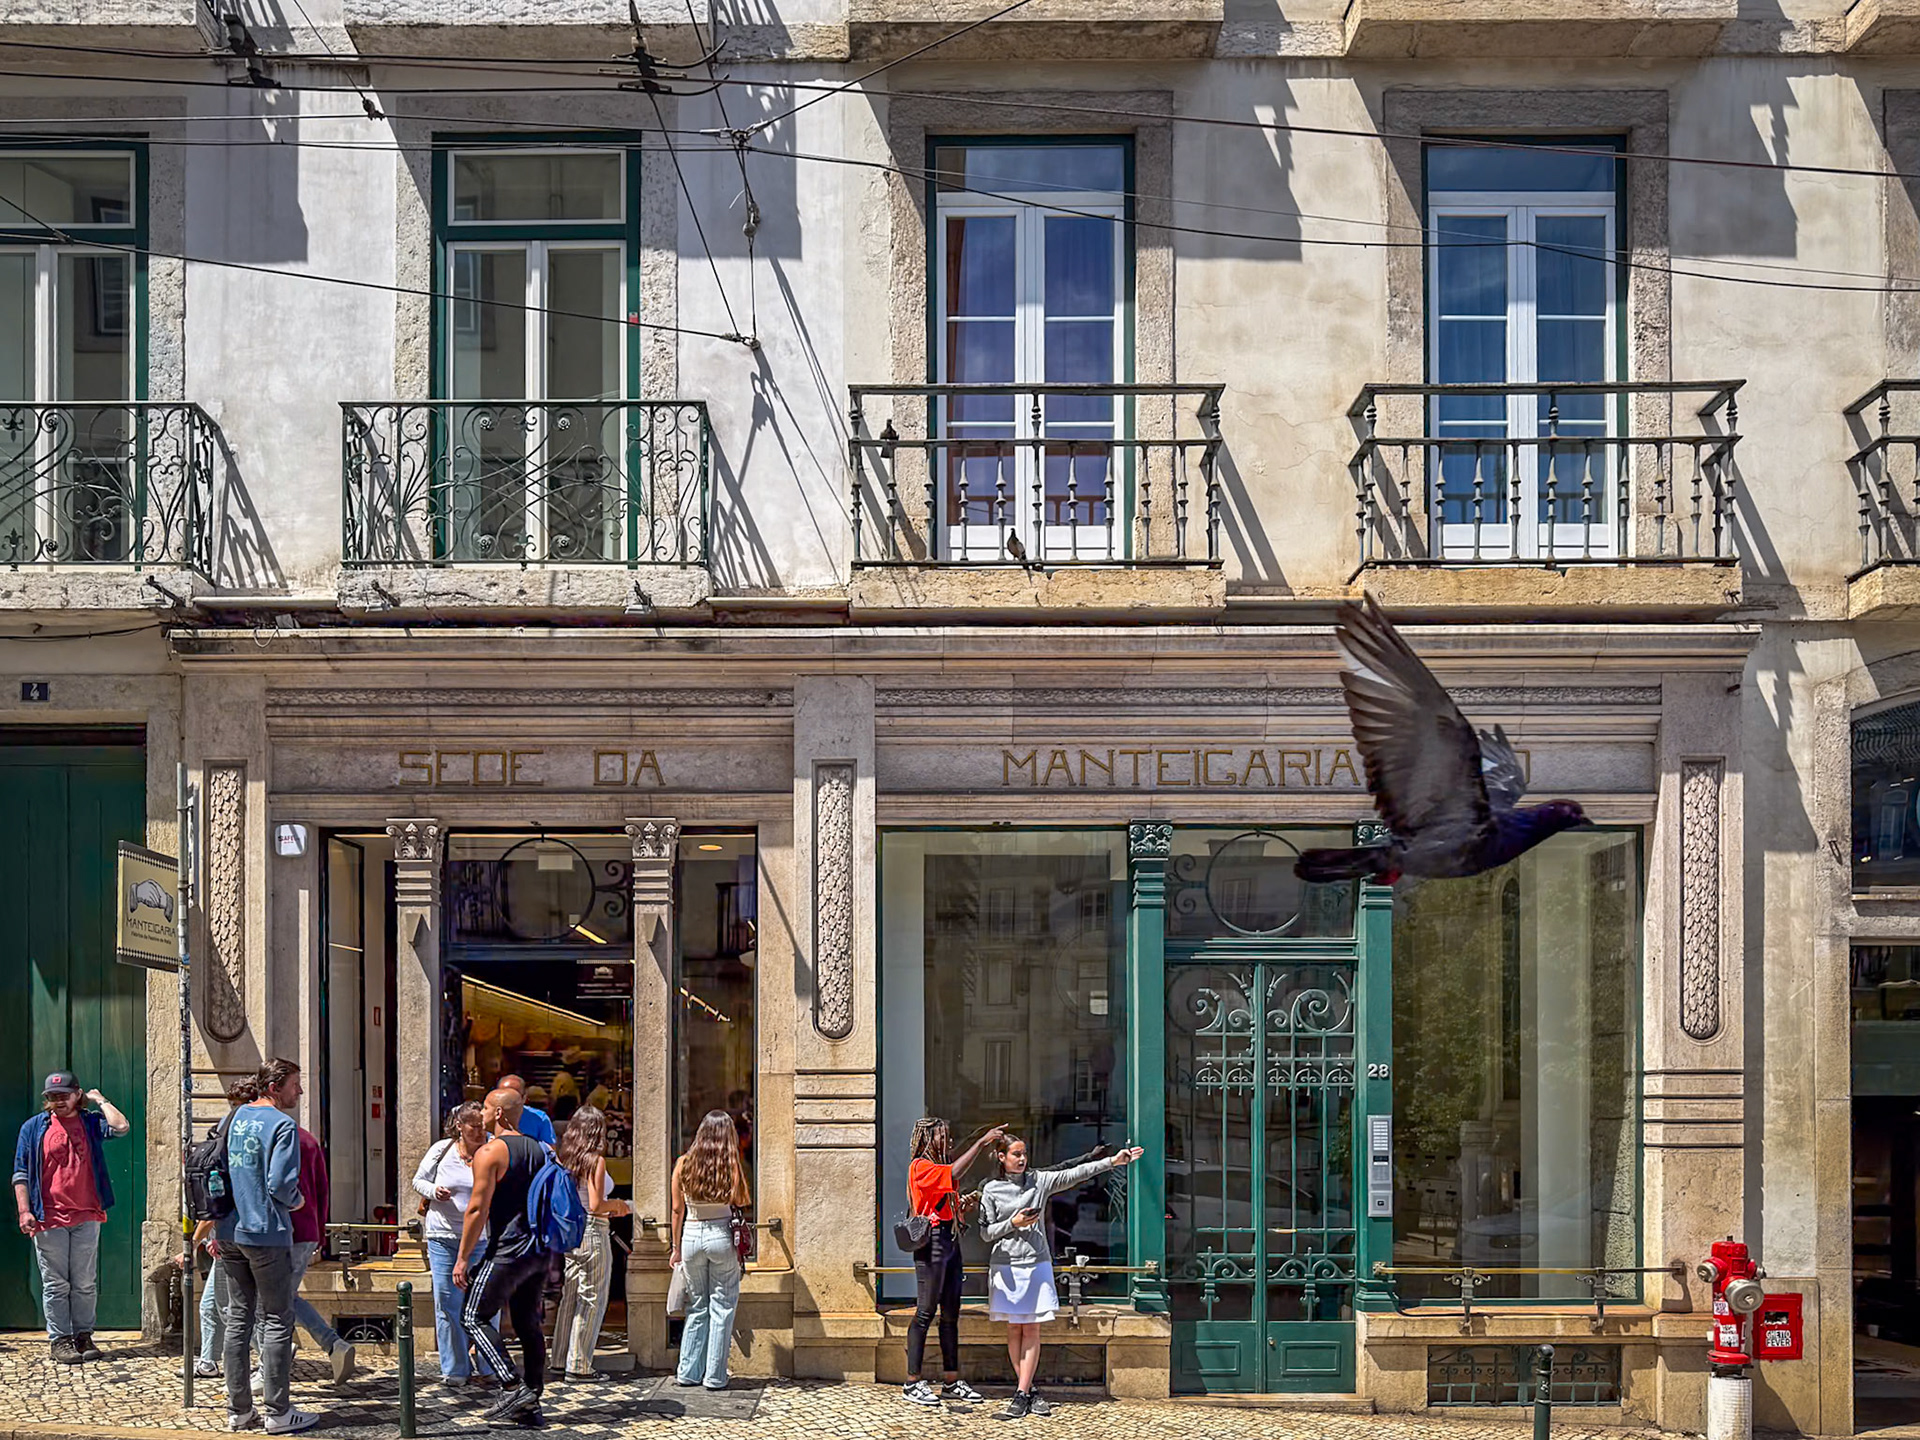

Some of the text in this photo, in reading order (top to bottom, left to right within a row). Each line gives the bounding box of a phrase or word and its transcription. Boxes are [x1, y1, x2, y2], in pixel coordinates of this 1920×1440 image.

[399, 749, 1361, 786] SEDE DA MANTEIGARIA
[125, 915, 177, 938] MANTEIGARIA
[1367, 1063, 1389, 1078] 28
[1766, 1338, 1791, 1346] FEVER
